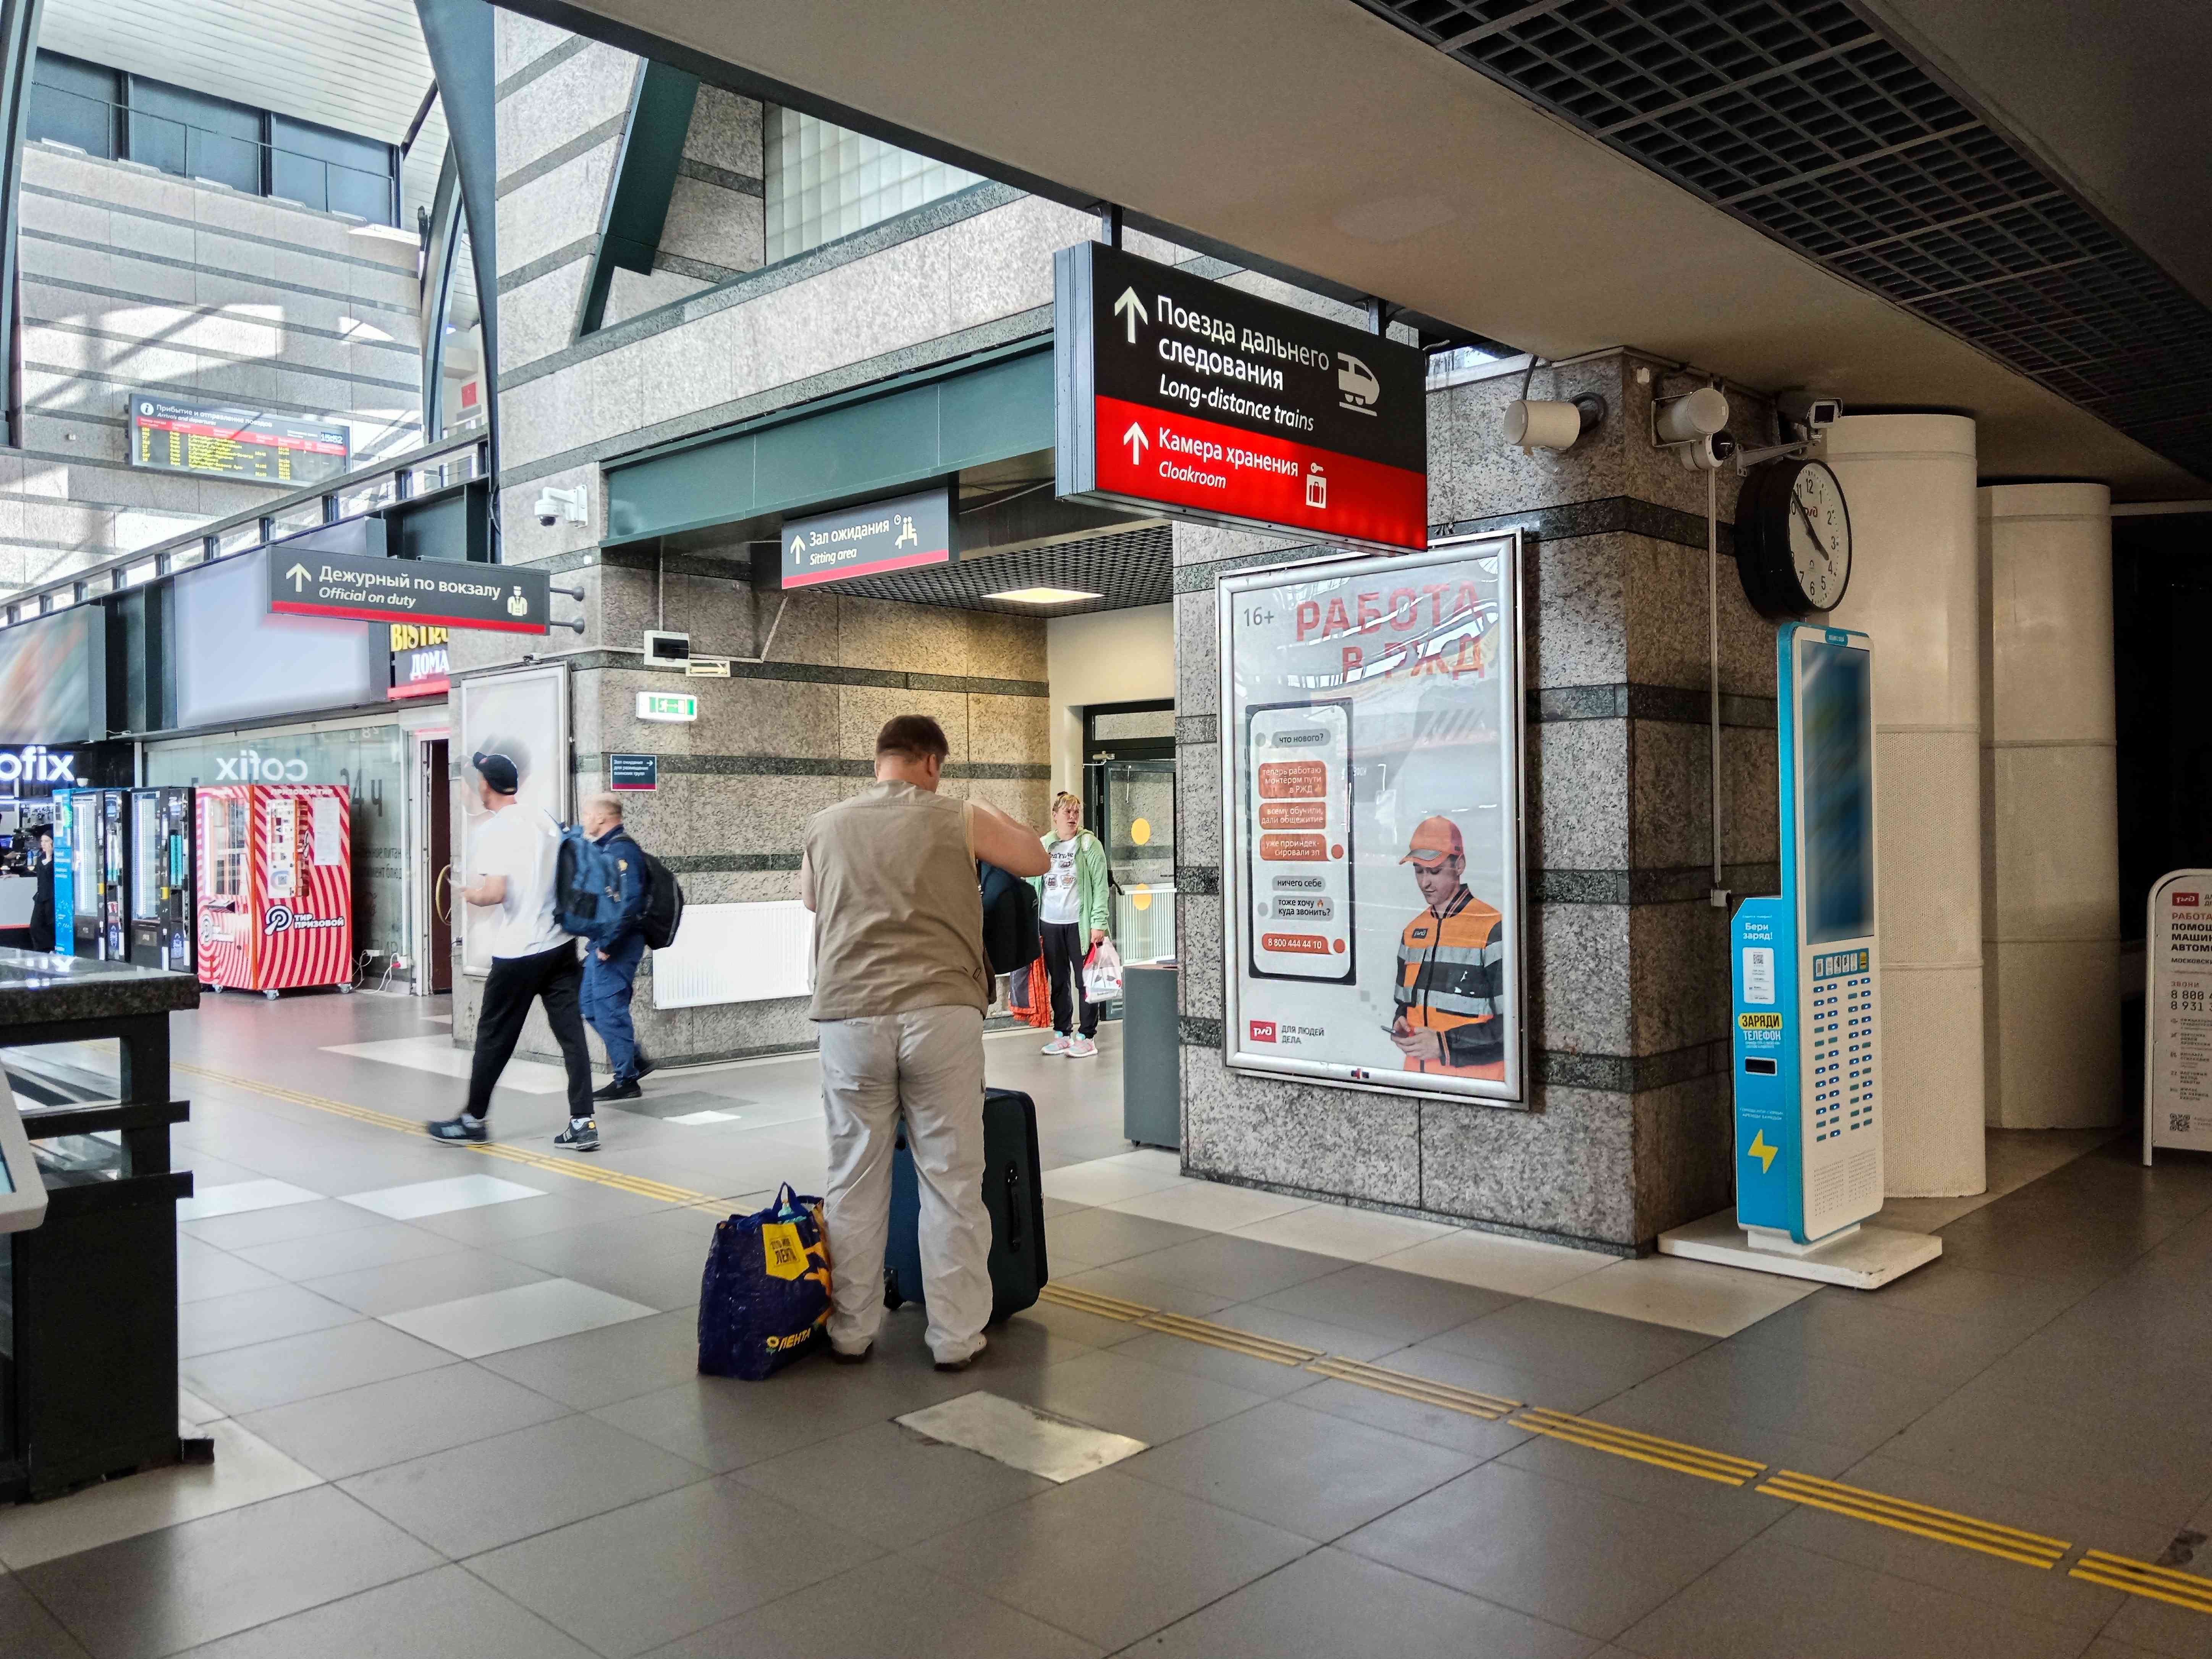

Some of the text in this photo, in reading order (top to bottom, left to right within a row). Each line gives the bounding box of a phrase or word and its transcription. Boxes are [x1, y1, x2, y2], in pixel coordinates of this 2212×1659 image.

[1158, 294, 1330, 372] Поезда дальнего
[1159, 338, 1284, 391] следования
[1159, 374, 1314, 431] Long-distance trains
[157, 404, 192, 416] Прибытие
[200, 412, 244, 423] отправление
[245, 418, 272, 427] поездов
[1159, 427, 1299, 477] Камера хранения
[1159, 461, 1227, 490] Cloakroom
[1806, 479, 1813, 494] 12
[1827, 511, 1832, 525] 2
[809, 519, 889, 547] Зал ожидания
[1831, 536, 1836, 550] 3
[810, 548, 857, 566] Sitting area
[1828, 561, 1833, 574] 4
[319, 566, 501, 600] Дежурный по вокзалу
[1799, 571, 1805, 584] 7
[1821, 576, 1826, 590] 5
[1810, 581, 1815, 596] 6
[319, 587, 416, 608] Official on duty
[1244, 606, 1274, 627] 16+
[1296, 580, 1485, 642] РАБОТА
[1342, 633, 1486, 683] В РЖД
[410, 649, 450, 681] ДОМА
[1293, 733, 1323, 742] нового?
[1289, 766, 1321, 776] работаю
[1295, 785, 1313, 794] РЖД
[1267, 807, 1323, 817] всему обучили,
[1280, 814, 1324, 824] общежитие
[1266, 841, 1279, 849] уже
[1274, 849, 1309, 857] сировали
[1304, 878, 1322, 887] себе
[1298, 900, 1314, 908] хочу
[294, 916, 344, 929] ПРИЗОВОЙ
[1745, 922, 1769, 932] Бери
[1743, 932, 1773, 941] заряд!
[1268, 938, 1273, 946] 8
[1274, 938, 1287, 947] 800
[1288, 939, 1300, 947] 444
[1313, 941, 1322, 949] 10
[2171, 990, 2204, 1000] 8 800
[2171, 1001, 2178, 1010] 8
[2182, 1001, 2203, 1011] 931
[1742, 1015, 1780, 1028] ЗАРЯДИ
[1281, 1025, 1297, 1033] ДЛЯ
[1298, 1026, 1324, 1036] ЛЮДЕЙ
[1743, 1030, 1781, 1041] ТЕЛЕФОН
[1281, 1035, 1302, 1044] ДЕЛА
[778, 1328, 811, 1352] ЛЕНТА
